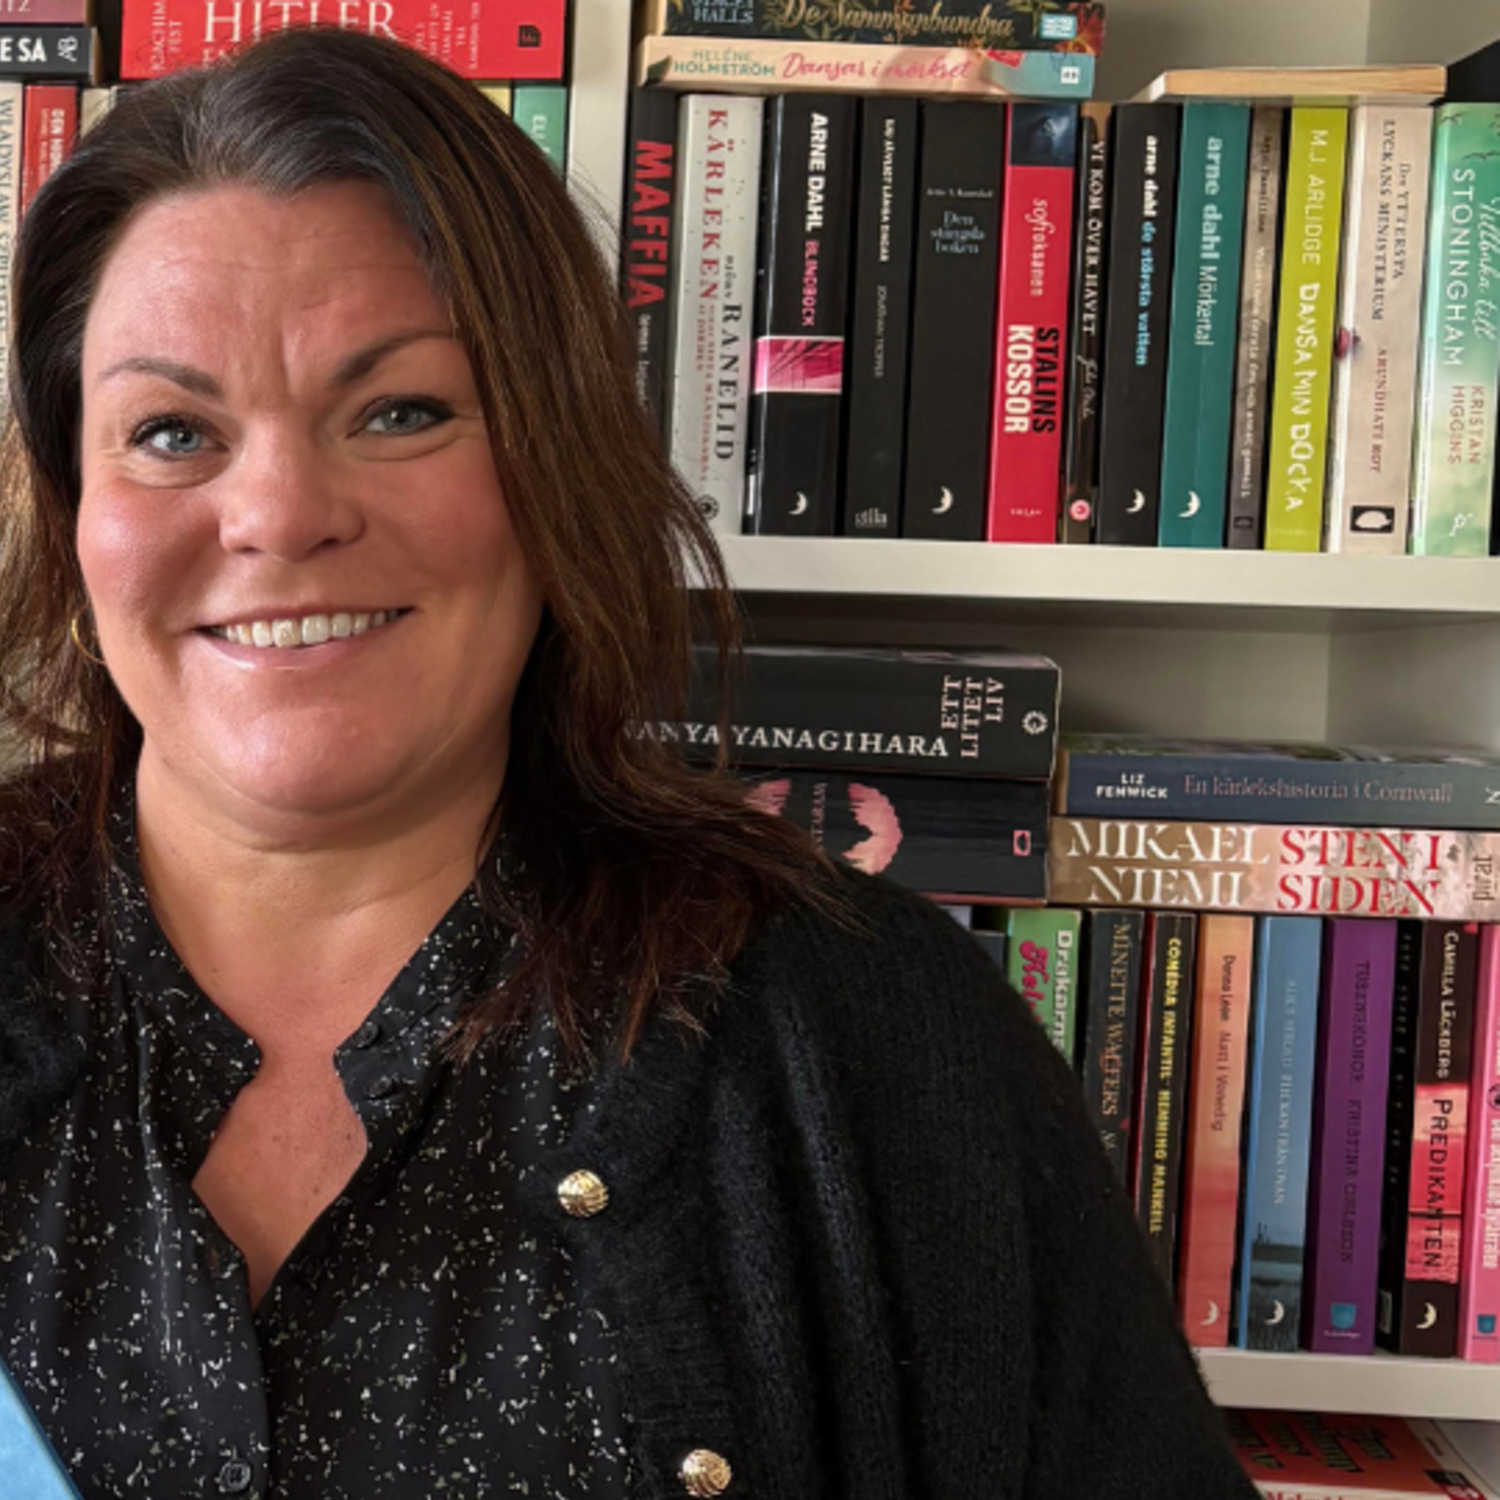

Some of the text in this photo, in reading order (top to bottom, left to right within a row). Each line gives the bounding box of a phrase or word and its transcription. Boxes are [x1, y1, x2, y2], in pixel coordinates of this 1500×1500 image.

[17, 38, 46, 64] SA
[201, 0, 398, 42] HITLER
[673, 61, 775, 78] HOLMSTRÖM
[626, 140, 674, 310] MAFFIA
[699, 109, 735, 301] KÄRLEKEN
[801, 113, 829, 327] ARNE DAHL BLINDBOCK
[1087, 168, 1105, 211] KOM
[1137, 136, 1160, 308] arne dahl de största
[1301, 174, 1326, 266] ARLIDGE
[1193, 136, 1224, 347] arne dahl Mörkertal
[1441, 168, 1475, 366] STONINGHAM
[1292, 282, 1321, 365] DANSA
[713, 303, 743, 462] RANELID
[1004, 324, 1036, 434] KOSSOR
[1033, 326, 1061, 435] STALINS
[1288, 370, 1317, 416] MIN
[1447, 386, 1467, 466] HIGGINS
[1467, 386, 1485, 465] KRISTAN
[1284, 423, 1316, 513] DOCKA
[941, 675, 963, 731] ETT
[960, 676, 984, 760] LITET
[985, 676, 1006, 724] LIV
[730, 726, 949, 759] YANAGIHARA
[1064, 821, 1270, 866] MIKAEL
[1279, 828, 1442, 871] STEN I
[1470, 854, 1494, 903] pirat
[1089, 866, 1247, 908] NIEMI
[1275, 873, 1441, 917] SIDEN
[1106, 923, 1131, 1020] MINETTE
[1422, 1099, 1455, 1270] PREDIKANTEN
